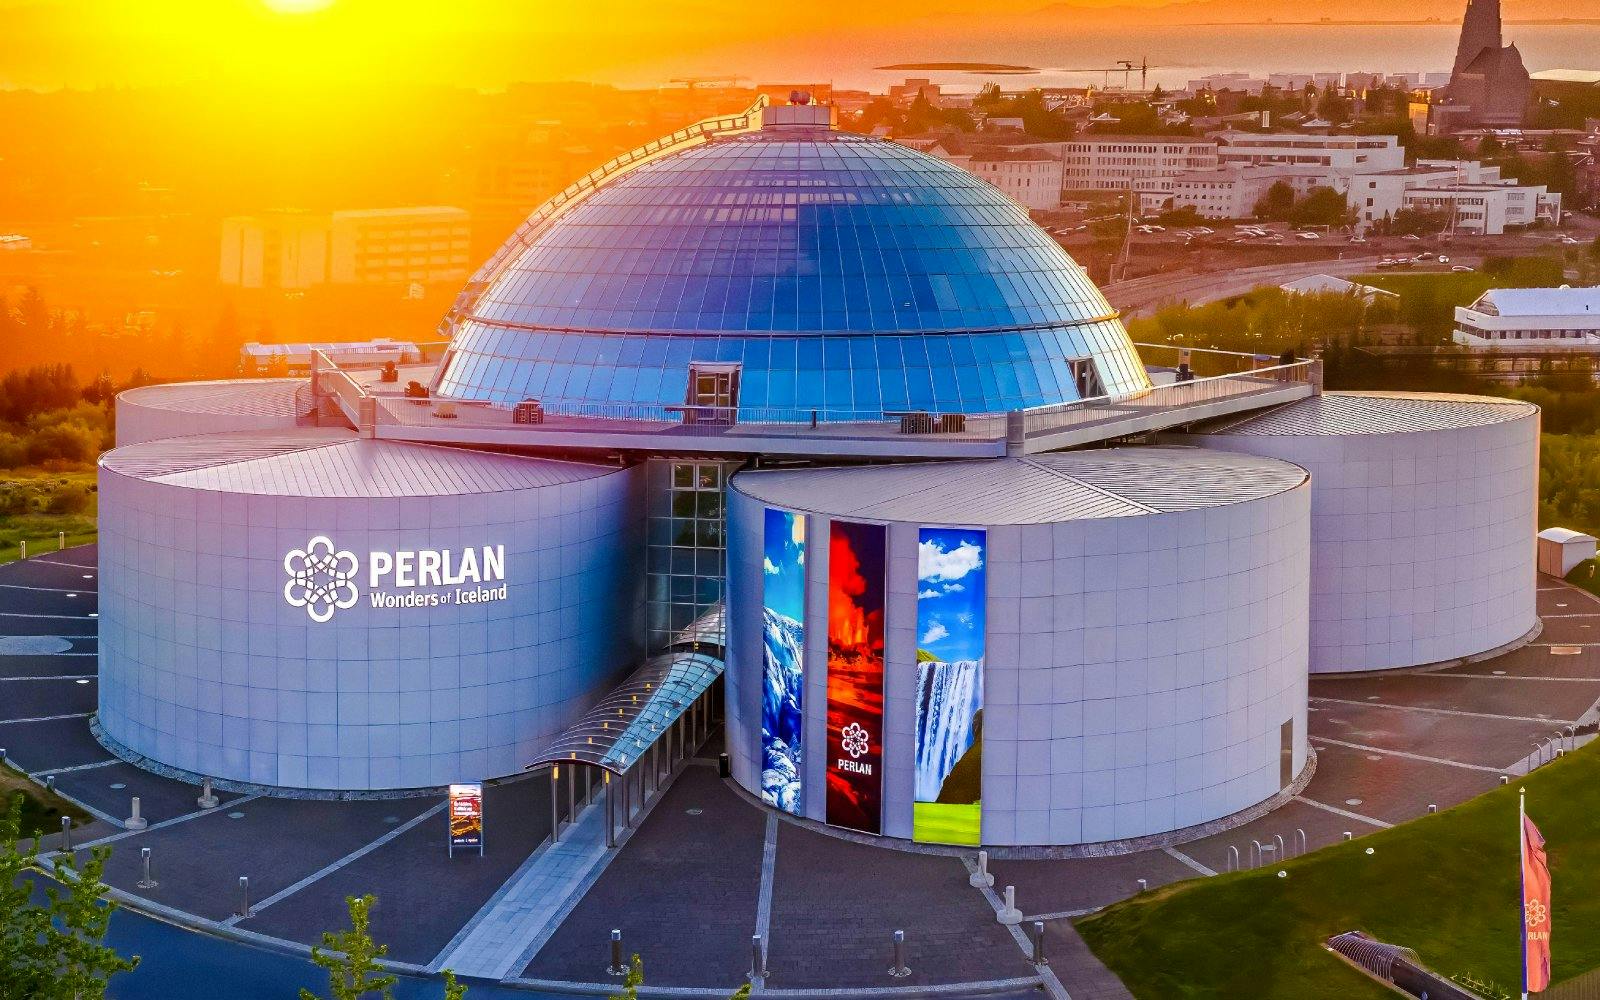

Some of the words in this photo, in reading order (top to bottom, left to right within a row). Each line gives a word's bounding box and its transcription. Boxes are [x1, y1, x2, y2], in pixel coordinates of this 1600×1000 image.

[370, 545, 505, 588] PERLAN
[371, 591, 439, 608] Wonders
[441, 593, 452, 604] of
[455, 583, 507, 605] Iceland
[838, 759, 872, 776] PERLAN
[1527, 931, 1550, 941] RLAN
